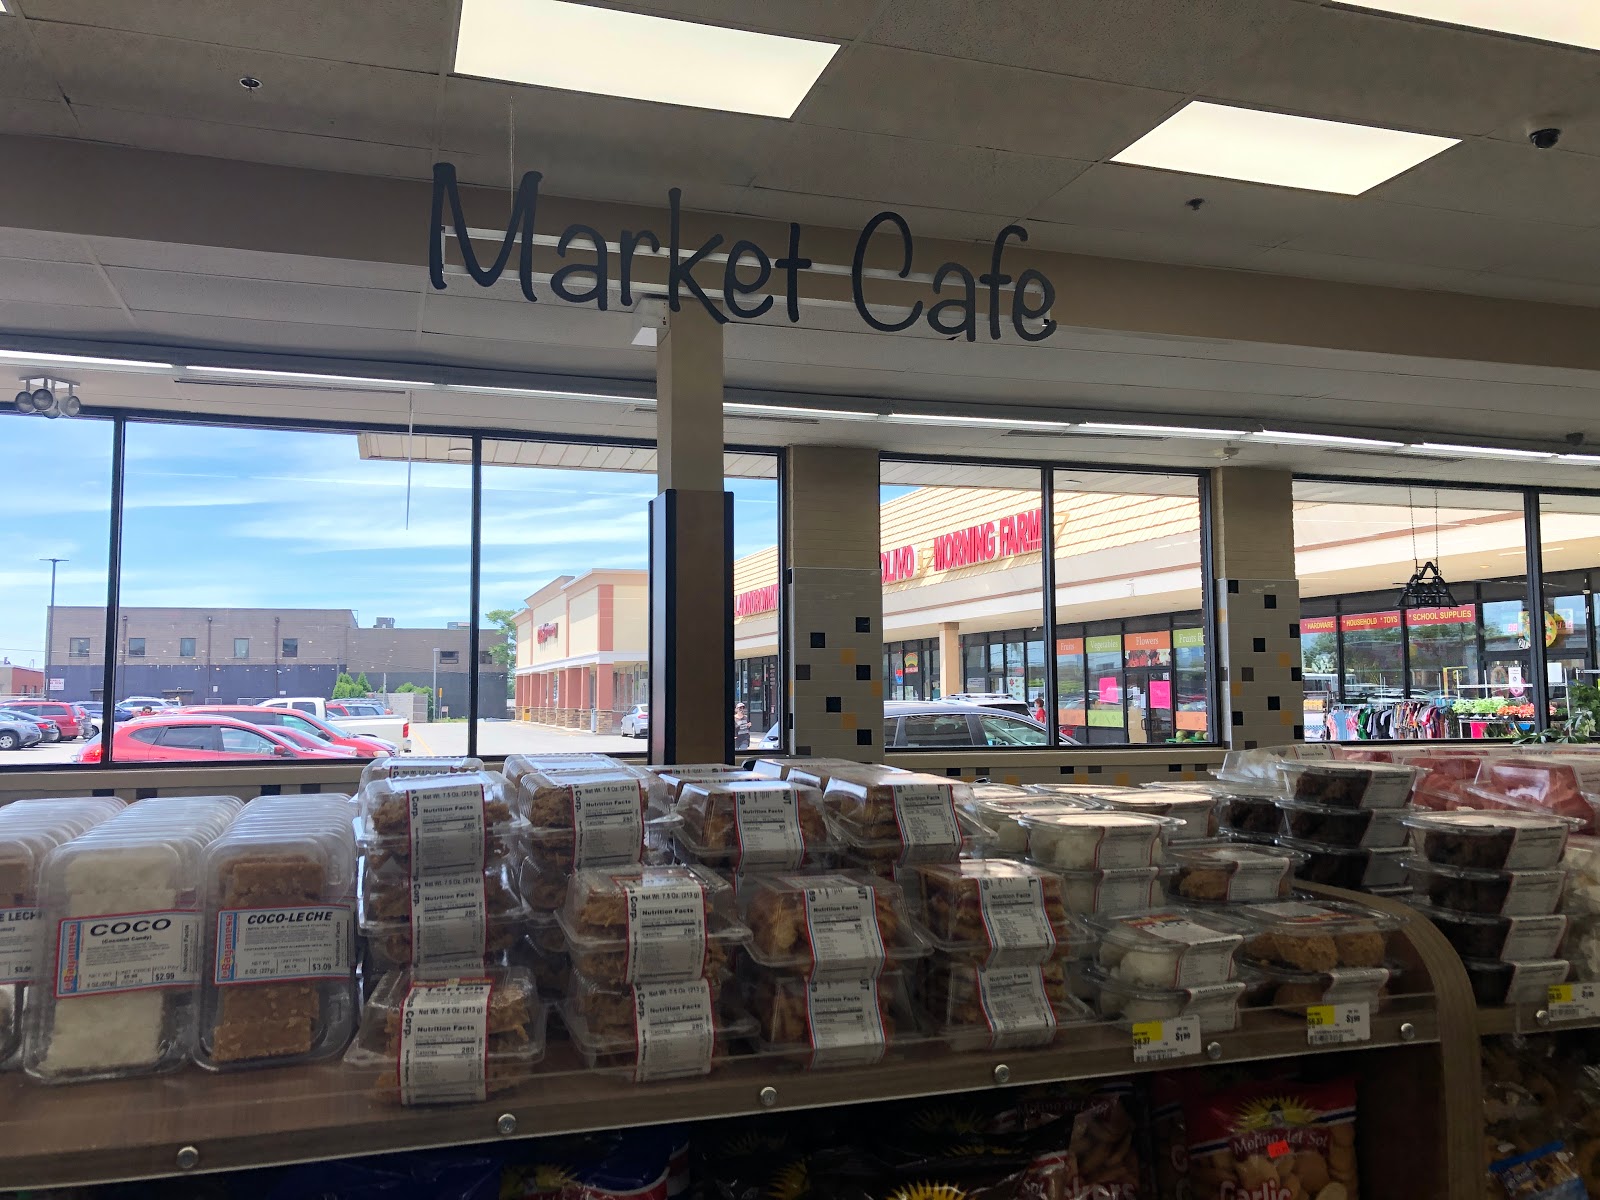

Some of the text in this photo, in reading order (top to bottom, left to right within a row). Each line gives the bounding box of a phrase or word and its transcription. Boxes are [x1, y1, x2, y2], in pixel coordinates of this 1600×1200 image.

[429, 161, 1056, 342] Market Cafe
[933, 521, 995, 572] MORNING
[999, 508, 1042, 557] FARM
[1346, 615, 1398, 627] HOUSEHOLD TOYS
[1412, 610, 1472, 621] SCHOOL SUPPLIES
[1307, 620, 1334, 630] HARDWARE
[1090, 640, 1118, 651] Vegetables
[1135, 636, 1159, 646] Flowers
[247, 911, 333, 925] COCO-LECHE
[90, 918, 171, 936] COCO
[313, 963, 332, 972] $3.09
[155, 973, 175, 982] $2.99
[1233, 1131, 1281, 1156] Molino
[1307, 1131, 1328, 1147] Sol
